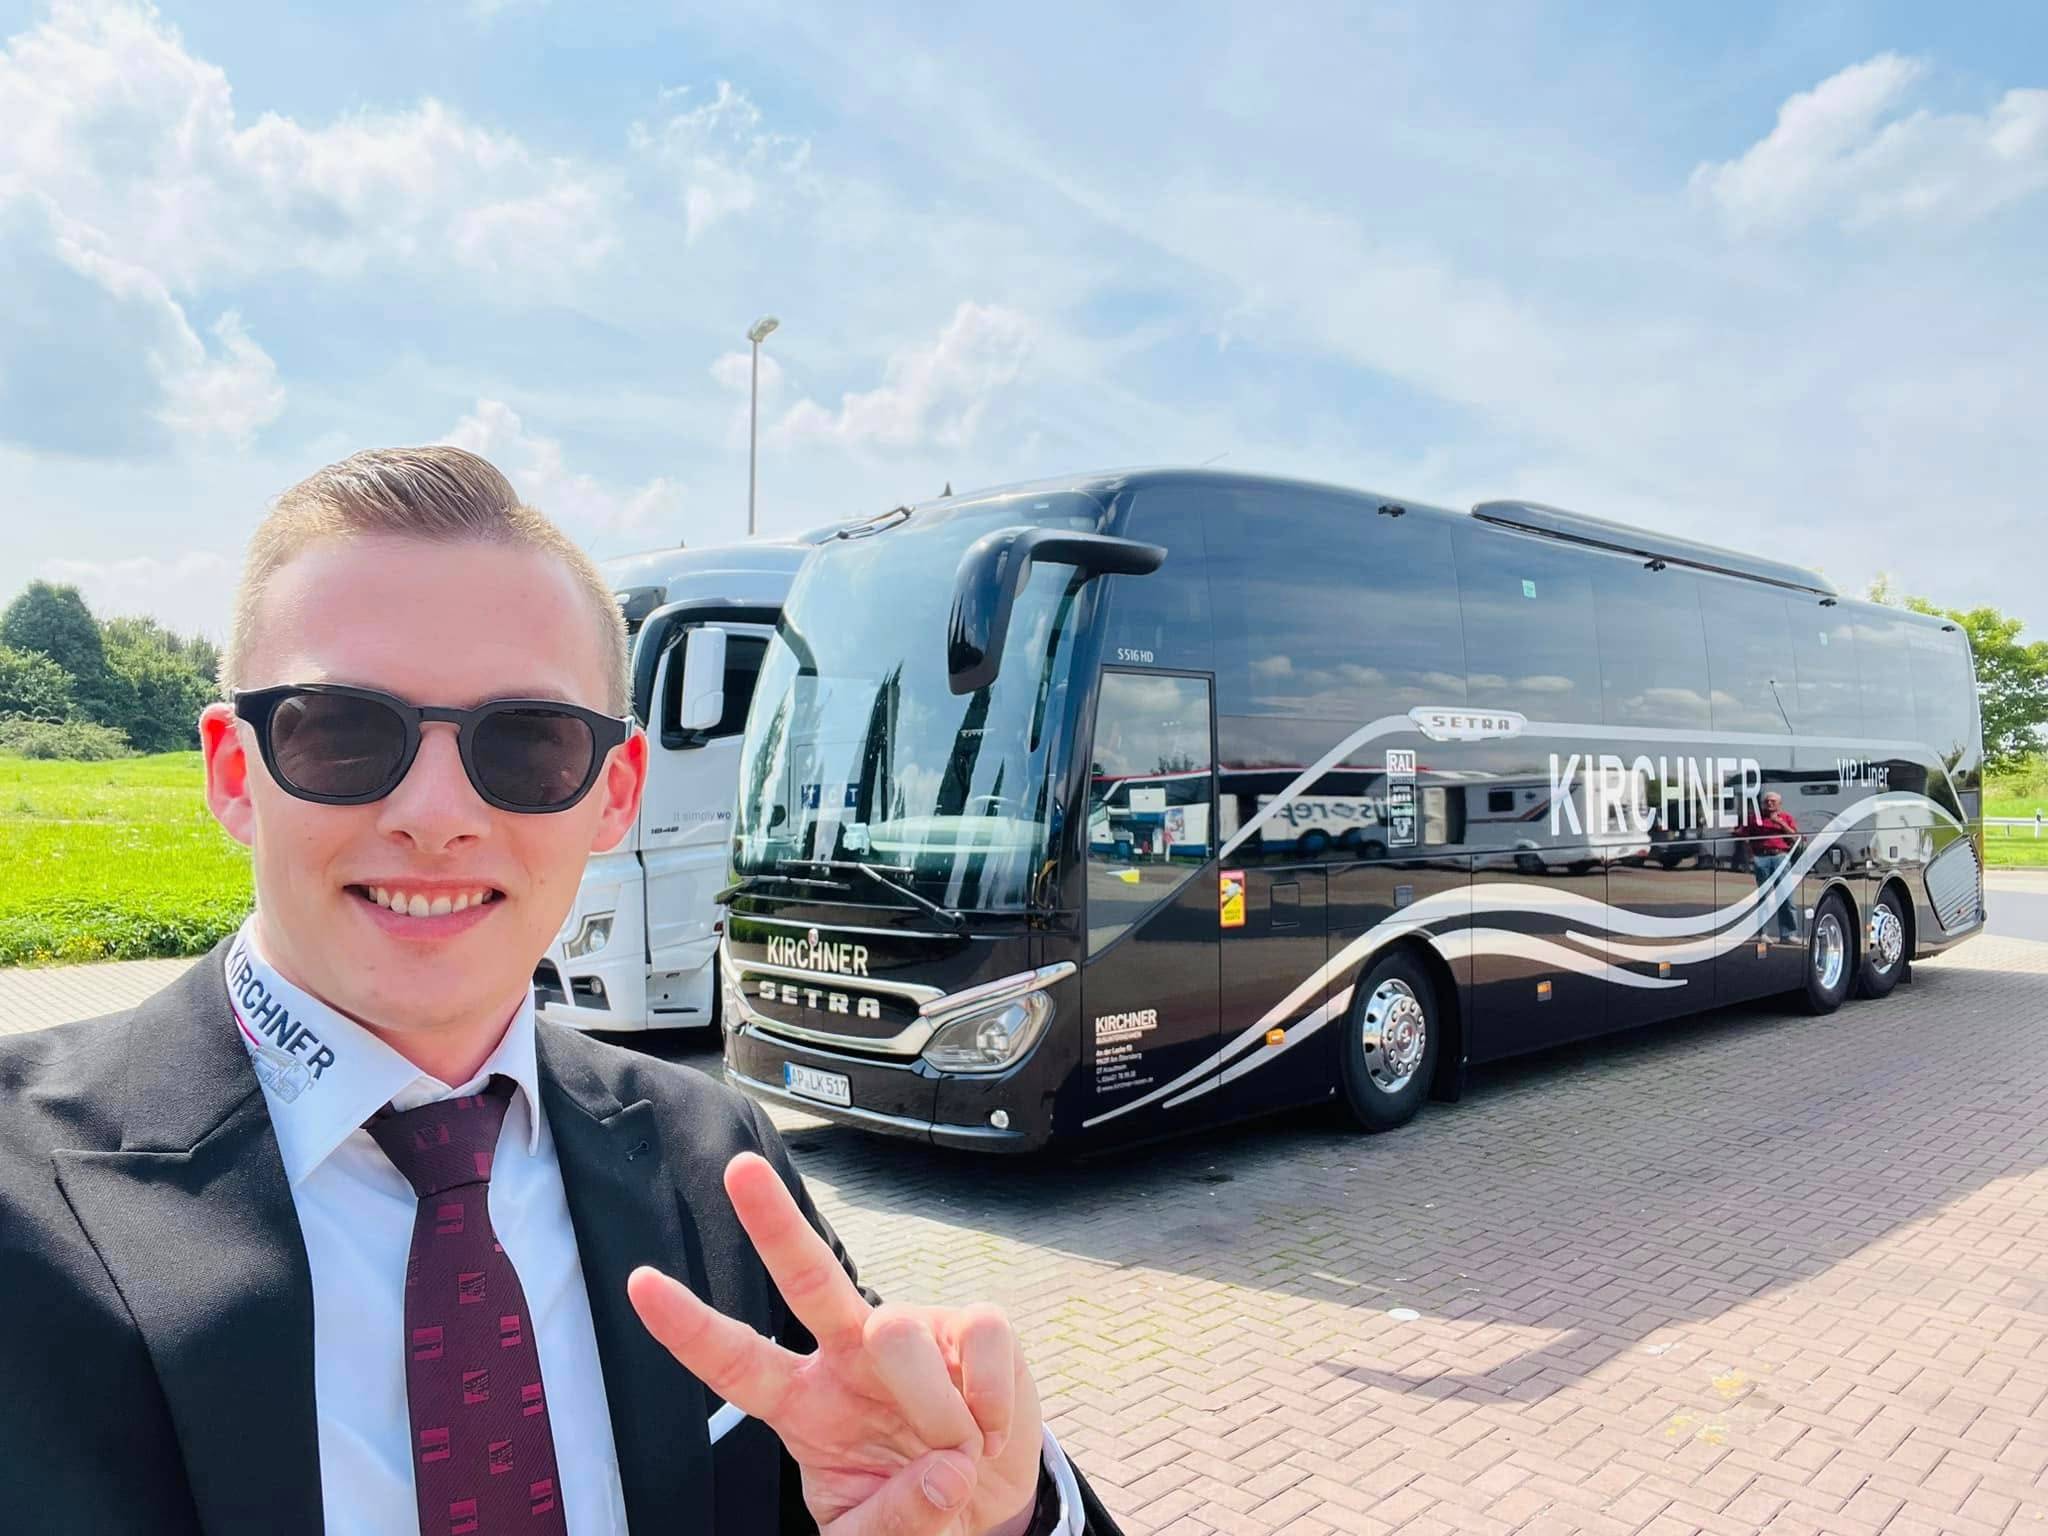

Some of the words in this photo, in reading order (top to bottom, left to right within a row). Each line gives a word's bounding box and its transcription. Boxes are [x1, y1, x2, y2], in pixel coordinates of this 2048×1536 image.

[1140, 650, 1154, 662] HD
[1431, 715, 1510, 731] SETRA
[1389, 754, 1413, 773] RAL
[1837, 758, 1857, 788] VIP
[1861, 759, 1889, 788] Liner
[1549, 753, 1763, 836] KIRCHNER
[767, 935, 869, 977] KIRCHNER
[229, 940, 335, 1080] KIRCHNER
[760, 980, 880, 1019] SETRA
[1095, 1009, 1157, 1033] KIRCHNER
